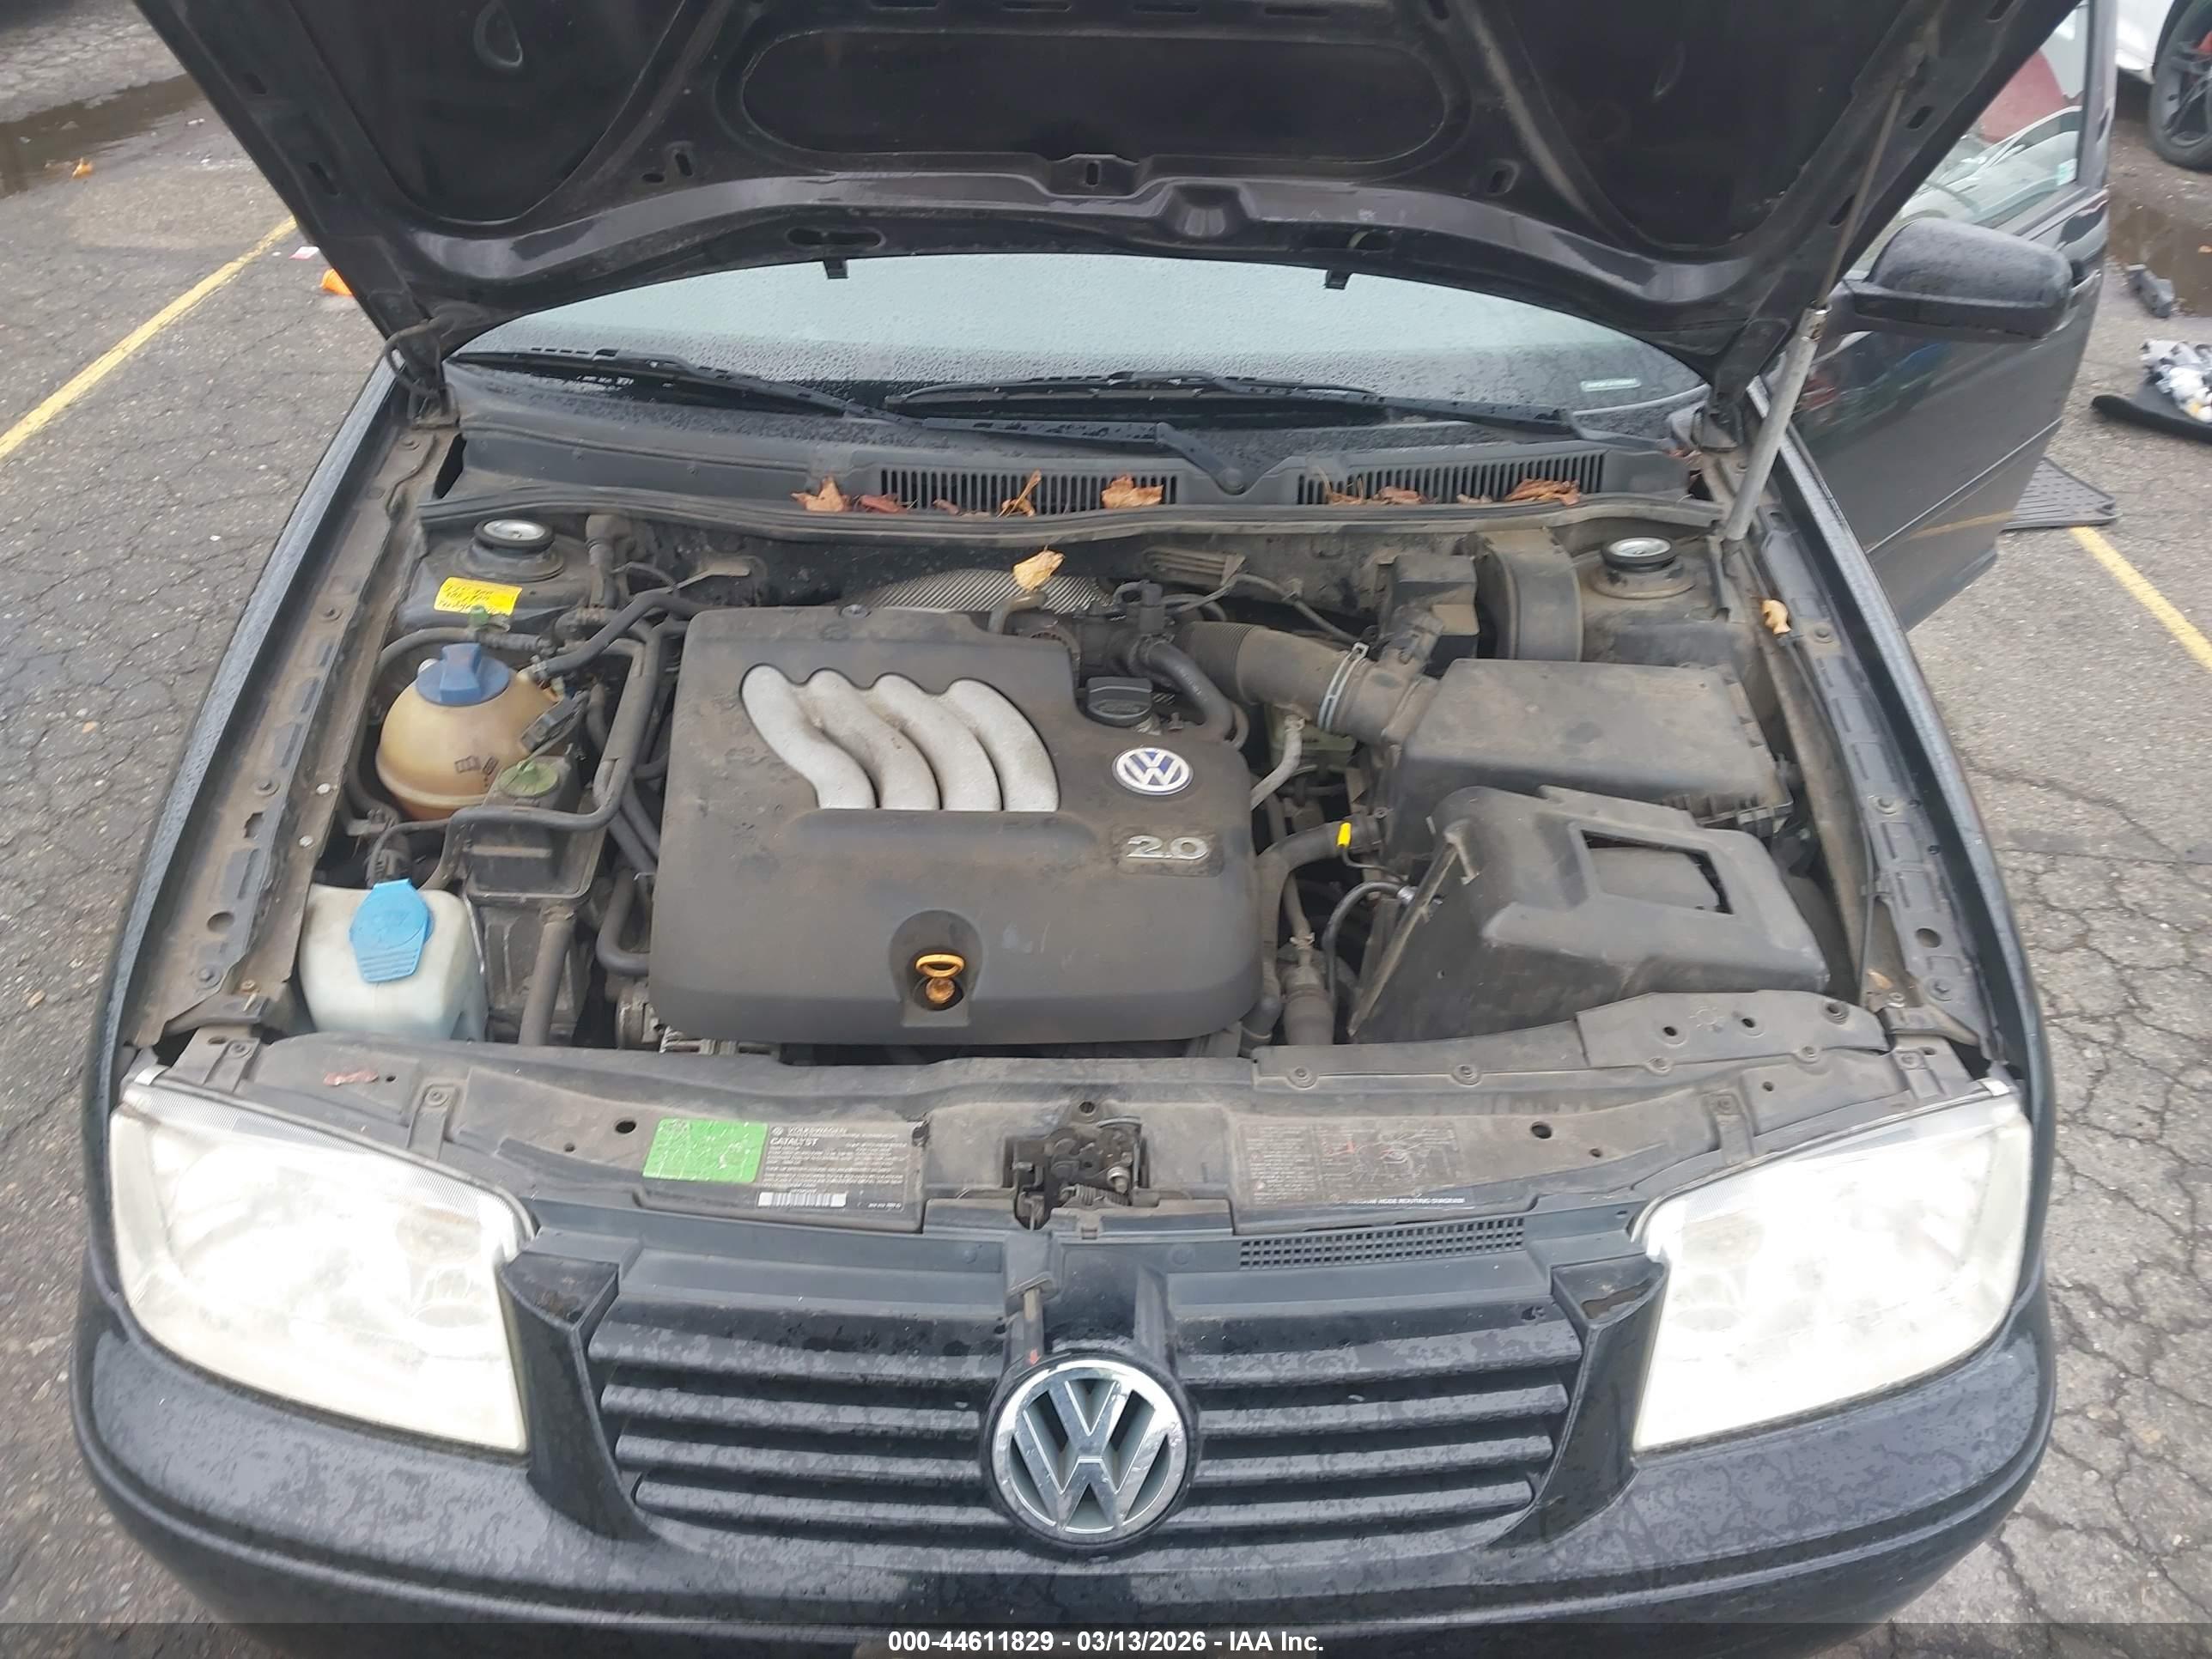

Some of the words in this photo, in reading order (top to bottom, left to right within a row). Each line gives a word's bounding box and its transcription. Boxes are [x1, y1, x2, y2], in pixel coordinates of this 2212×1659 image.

[1115, 747, 1191, 794] VW
[1126, 835, 1209, 860] 2.0
[992, 1359, 1188, 1546] VW
